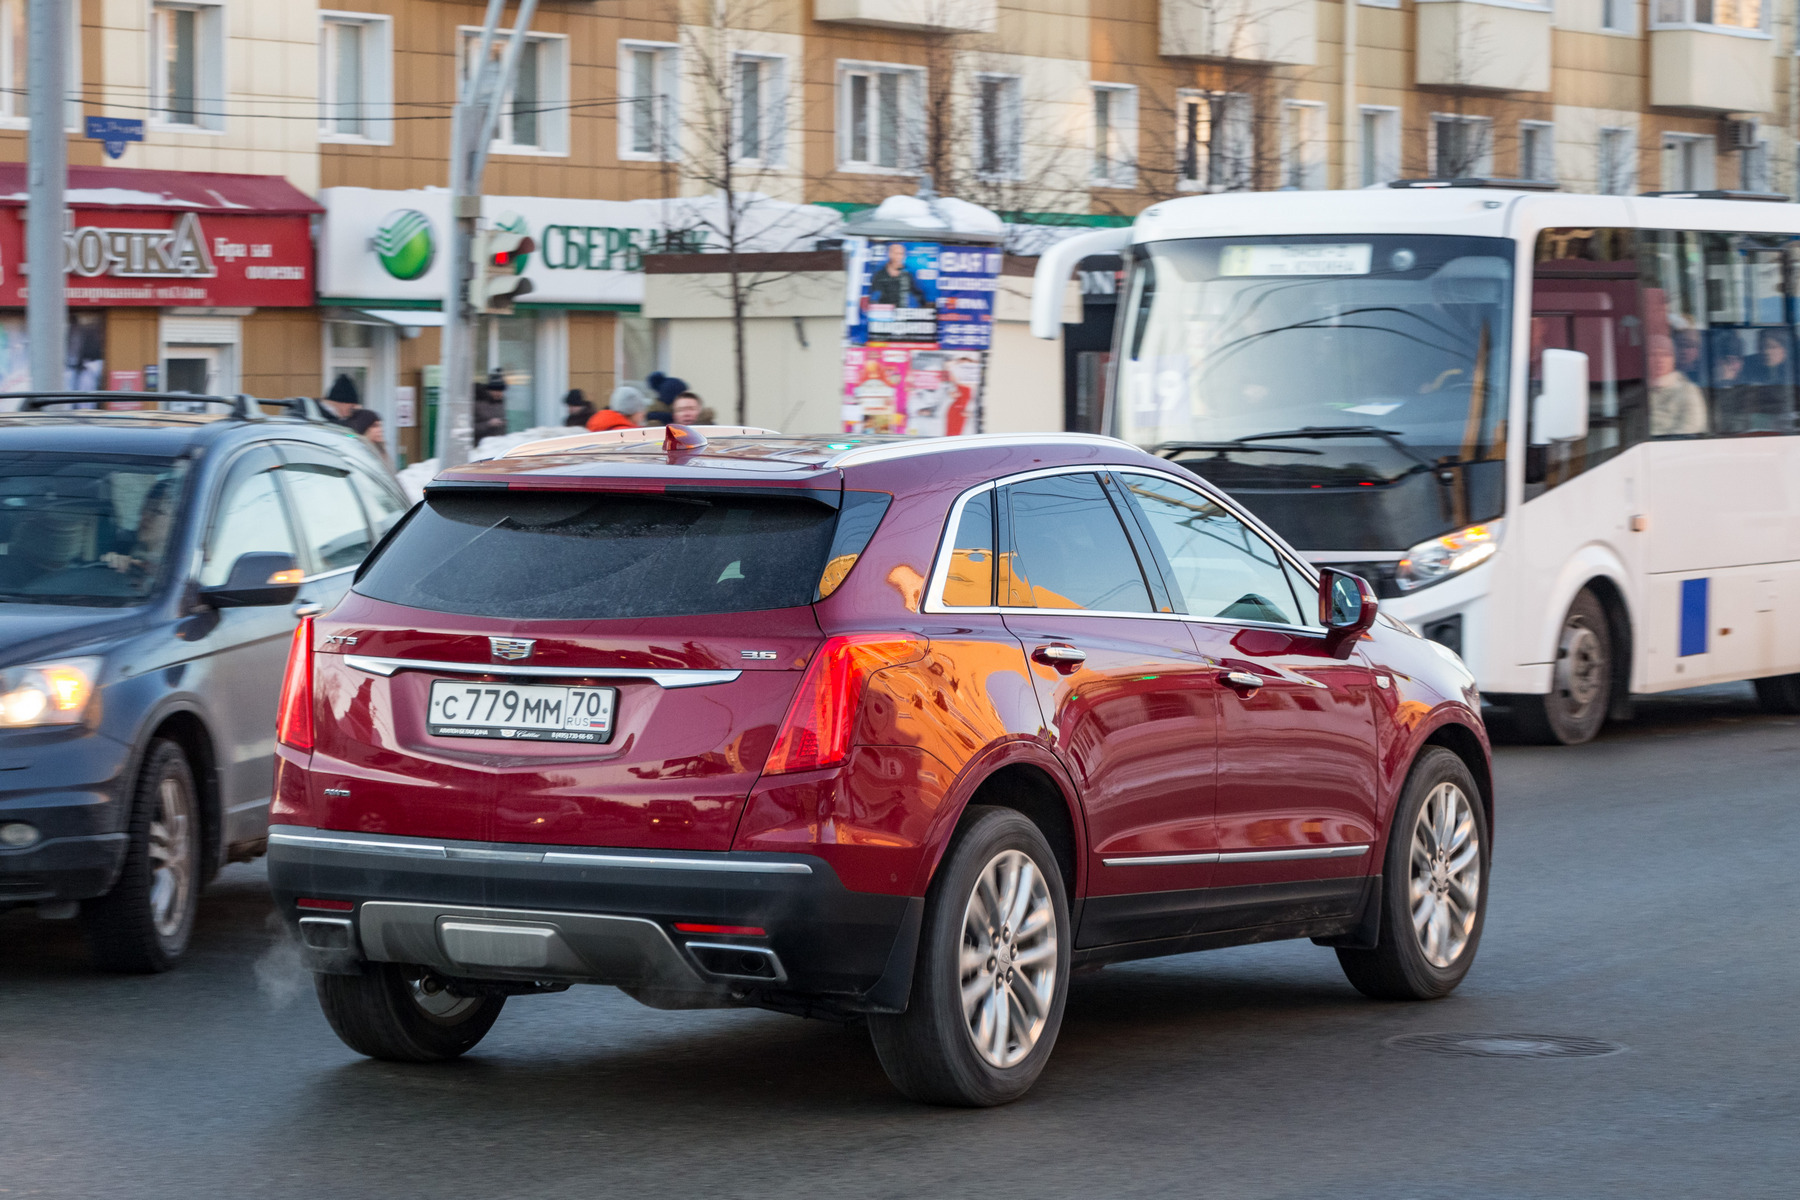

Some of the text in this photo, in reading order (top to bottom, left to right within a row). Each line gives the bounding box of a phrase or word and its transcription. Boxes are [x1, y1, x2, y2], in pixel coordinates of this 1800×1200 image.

[324, 634, 358, 646] XT5
[572, 692, 601, 717] 70
[566, 717, 589, 728] RUS
